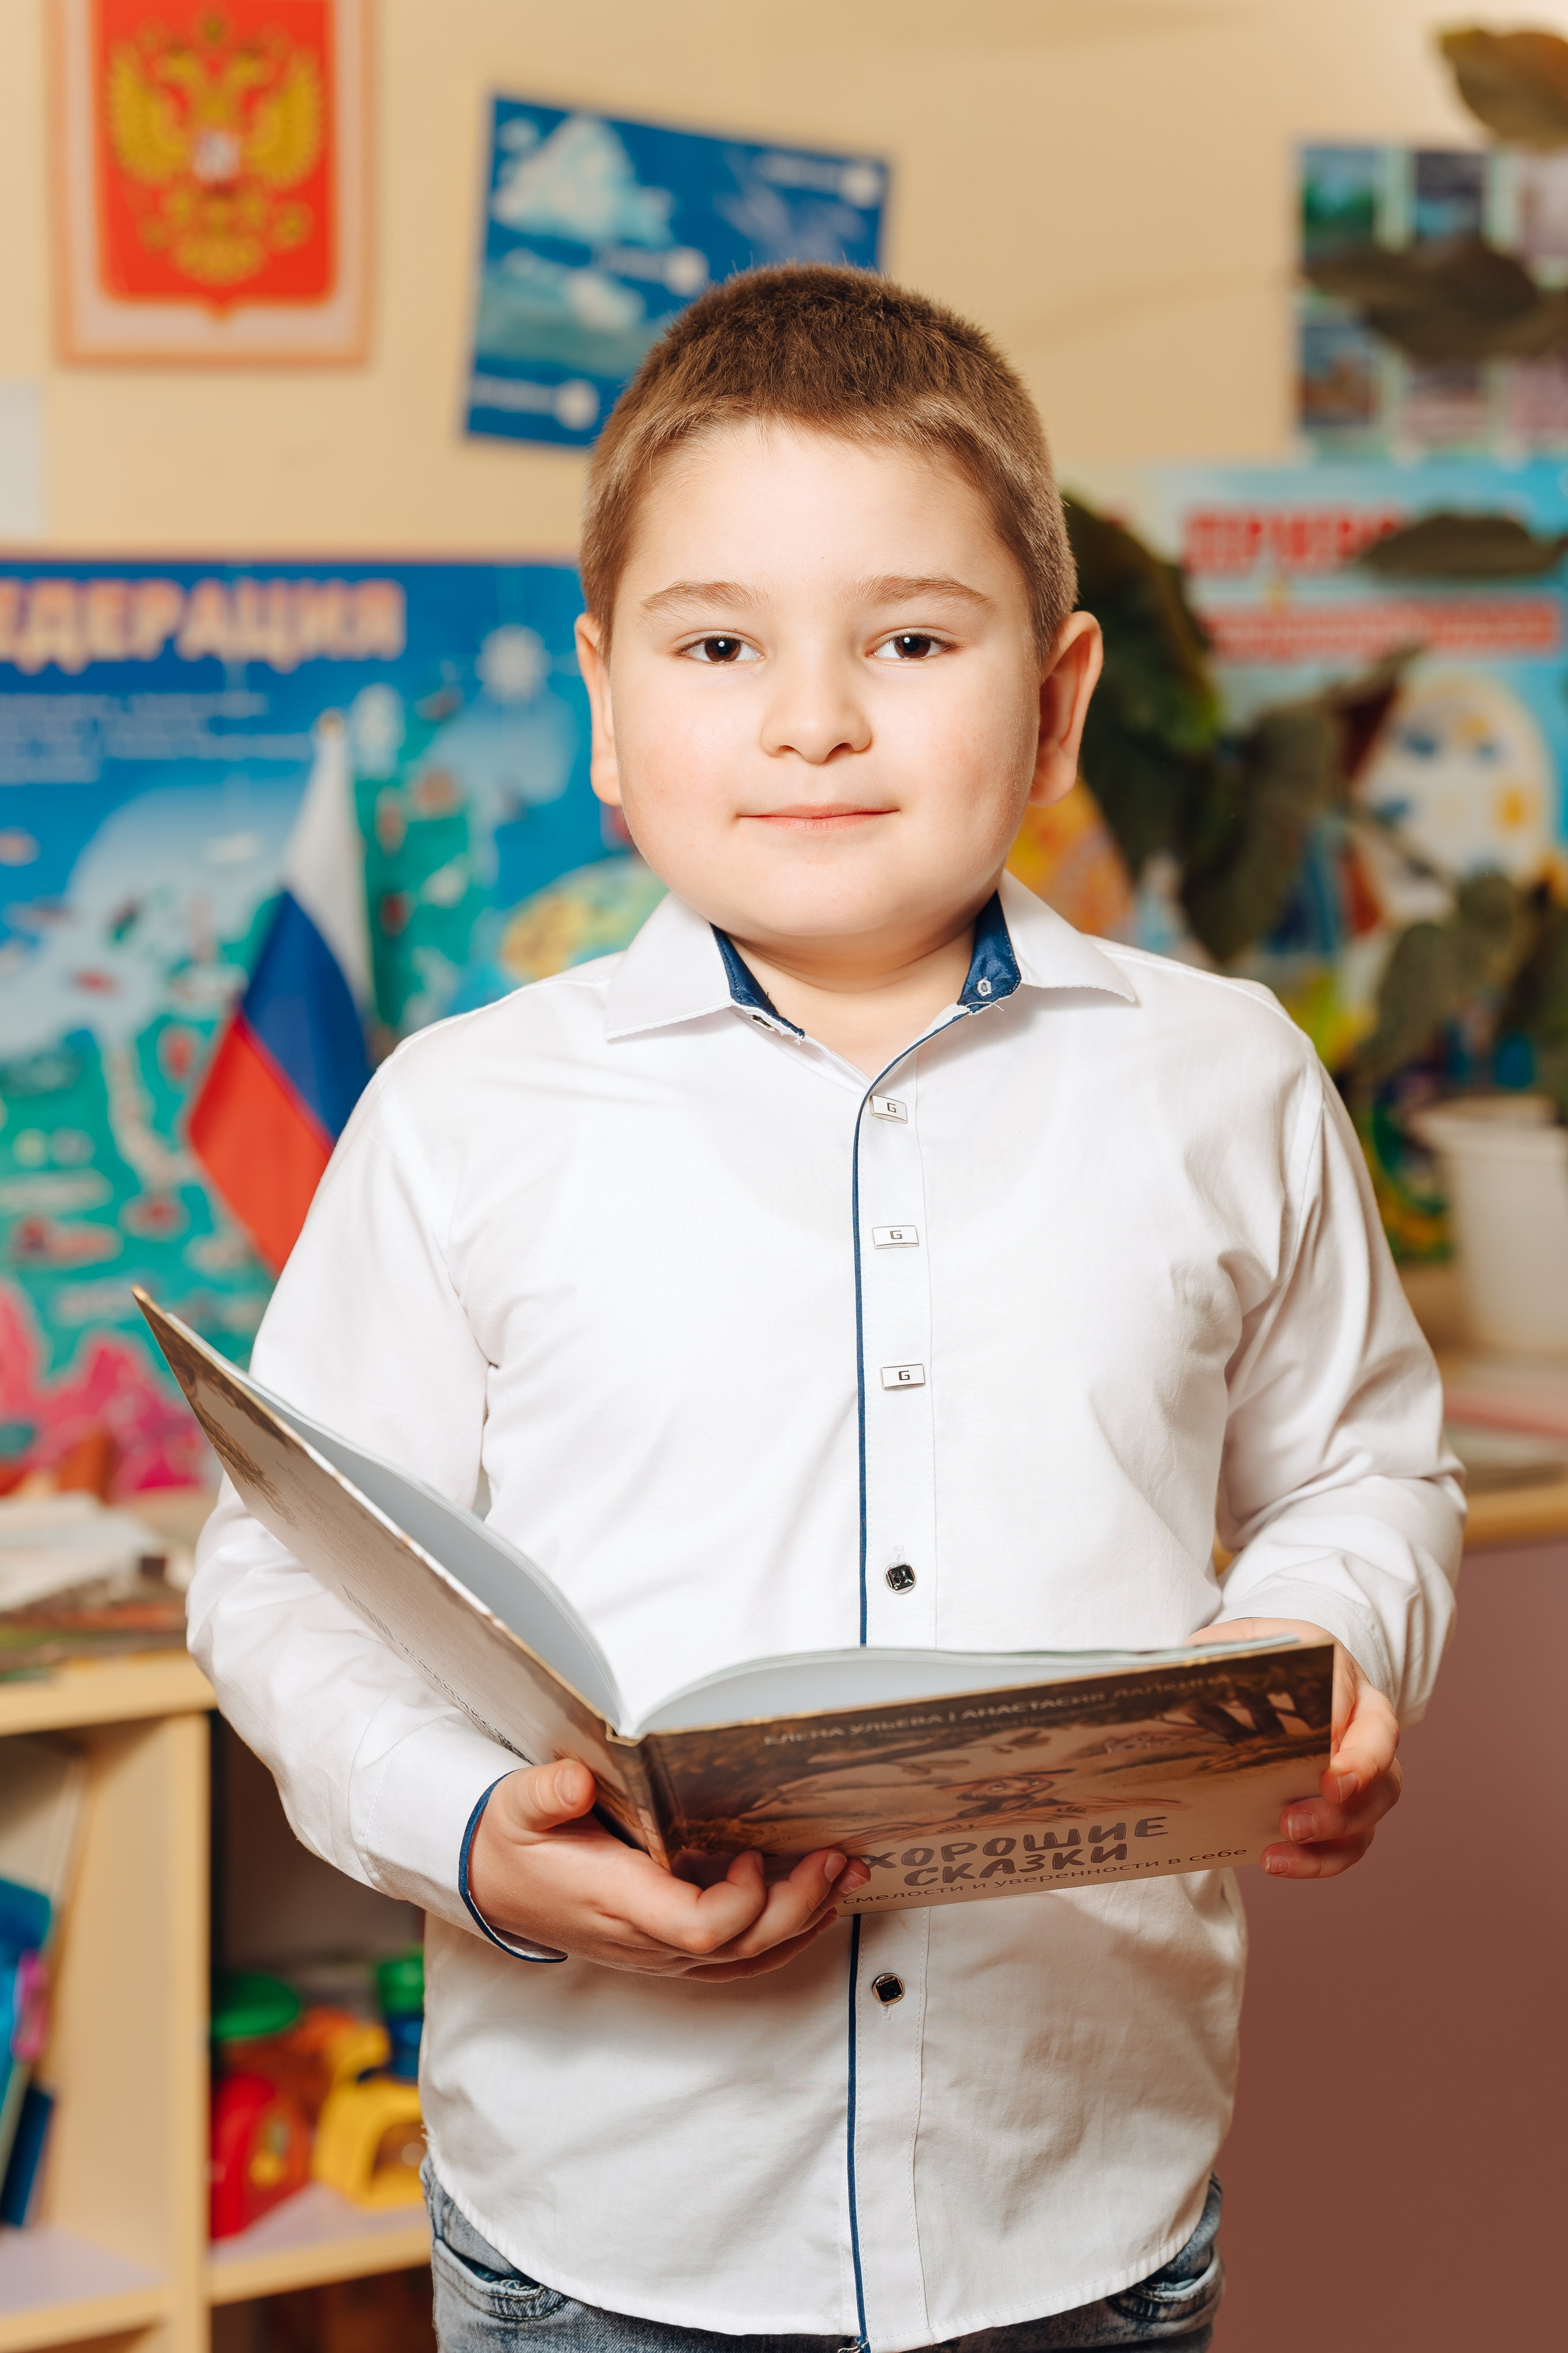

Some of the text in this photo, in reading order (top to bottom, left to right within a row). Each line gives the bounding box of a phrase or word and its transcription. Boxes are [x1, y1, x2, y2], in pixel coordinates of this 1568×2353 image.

[887, 1102, 896, 1113] G
[890, 1230, 903, 1239] G
[899, 1370, 910, 1381] G
[764, 1726, 845, 1746] ЕЛЕНА
[849, 1713, 944, 1734] УЛЬЕВА
[961, 1691, 1106, 1720] АНАСТАСИЯ
[861, 1816, 1169, 1869] ХОРОШИЕ
[842, 1885, 963, 1905] смелости
[993, 1860, 1159, 1888] уверенности
[1189, 1848, 1247, 1862] себе
[903, 1843, 1128, 1887] СКАЗКИ
